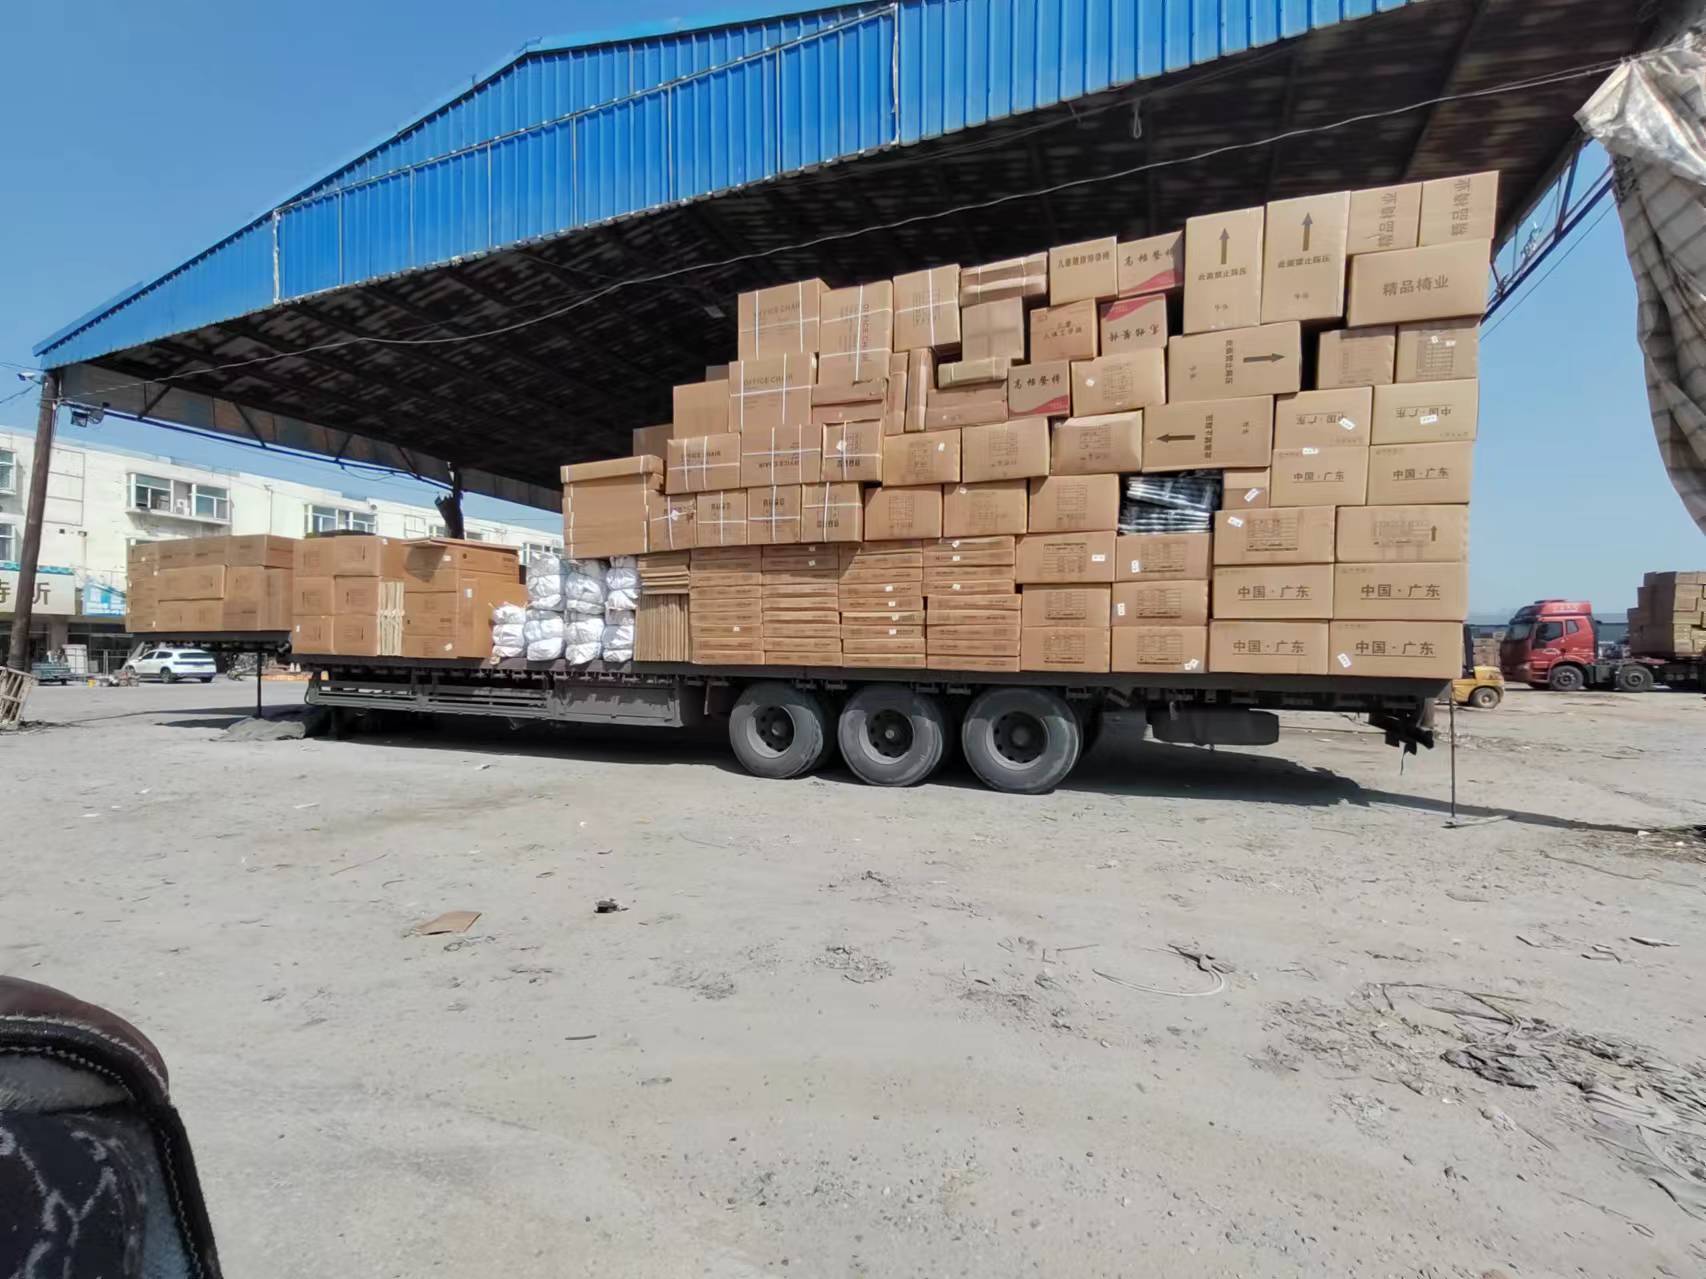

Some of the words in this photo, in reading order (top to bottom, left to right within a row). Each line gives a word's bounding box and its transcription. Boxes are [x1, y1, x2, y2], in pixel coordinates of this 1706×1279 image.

[1451, 177, 1471, 237] 精品椅业
[1378, 191, 1397, 247] 精品椅业
[1382, 274, 1449, 297] 精品椅业
[1396, 405, 1452, 419] 中国·广东
[1293, 470, 1345, 481] 中国·广东
[1392, 467, 1449, 480] 中国·广东
[1237, 584, 1310, 599] 中国·广东
[1360, 583, 1440, 598] 中国·广东
[1233, 640, 1305, 654] 中国·广东
[1355, 640, 1436, 655] 中国·广东
